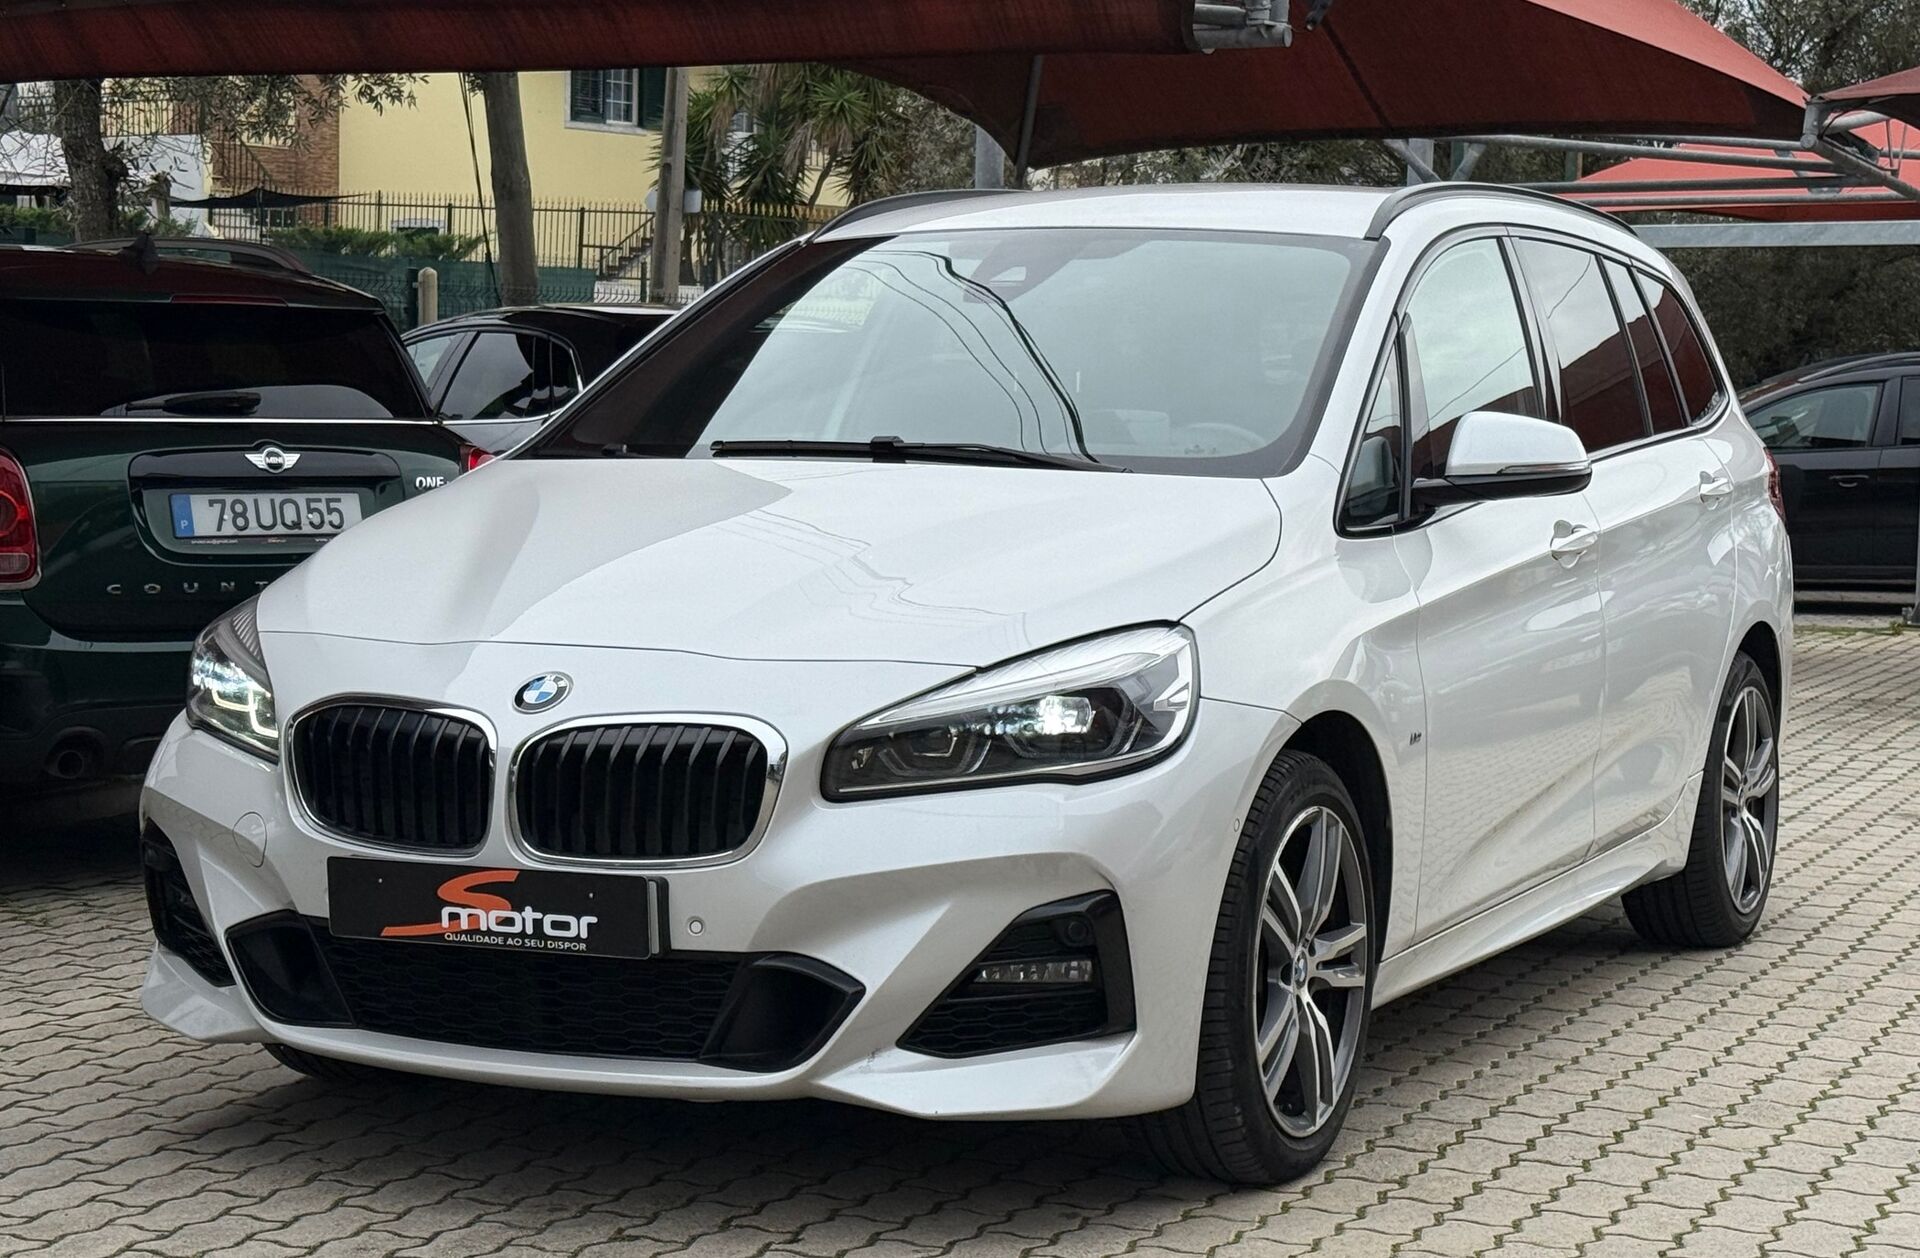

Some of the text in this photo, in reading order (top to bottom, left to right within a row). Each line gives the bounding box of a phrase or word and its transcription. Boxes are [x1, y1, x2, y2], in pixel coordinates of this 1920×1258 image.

[415, 476, 444, 489] ONE
[181, 520, 189, 530] P
[441, 905, 598, 939] motor
[444, 932, 587, 951] QUALIDADE AO SEU DISPOR
